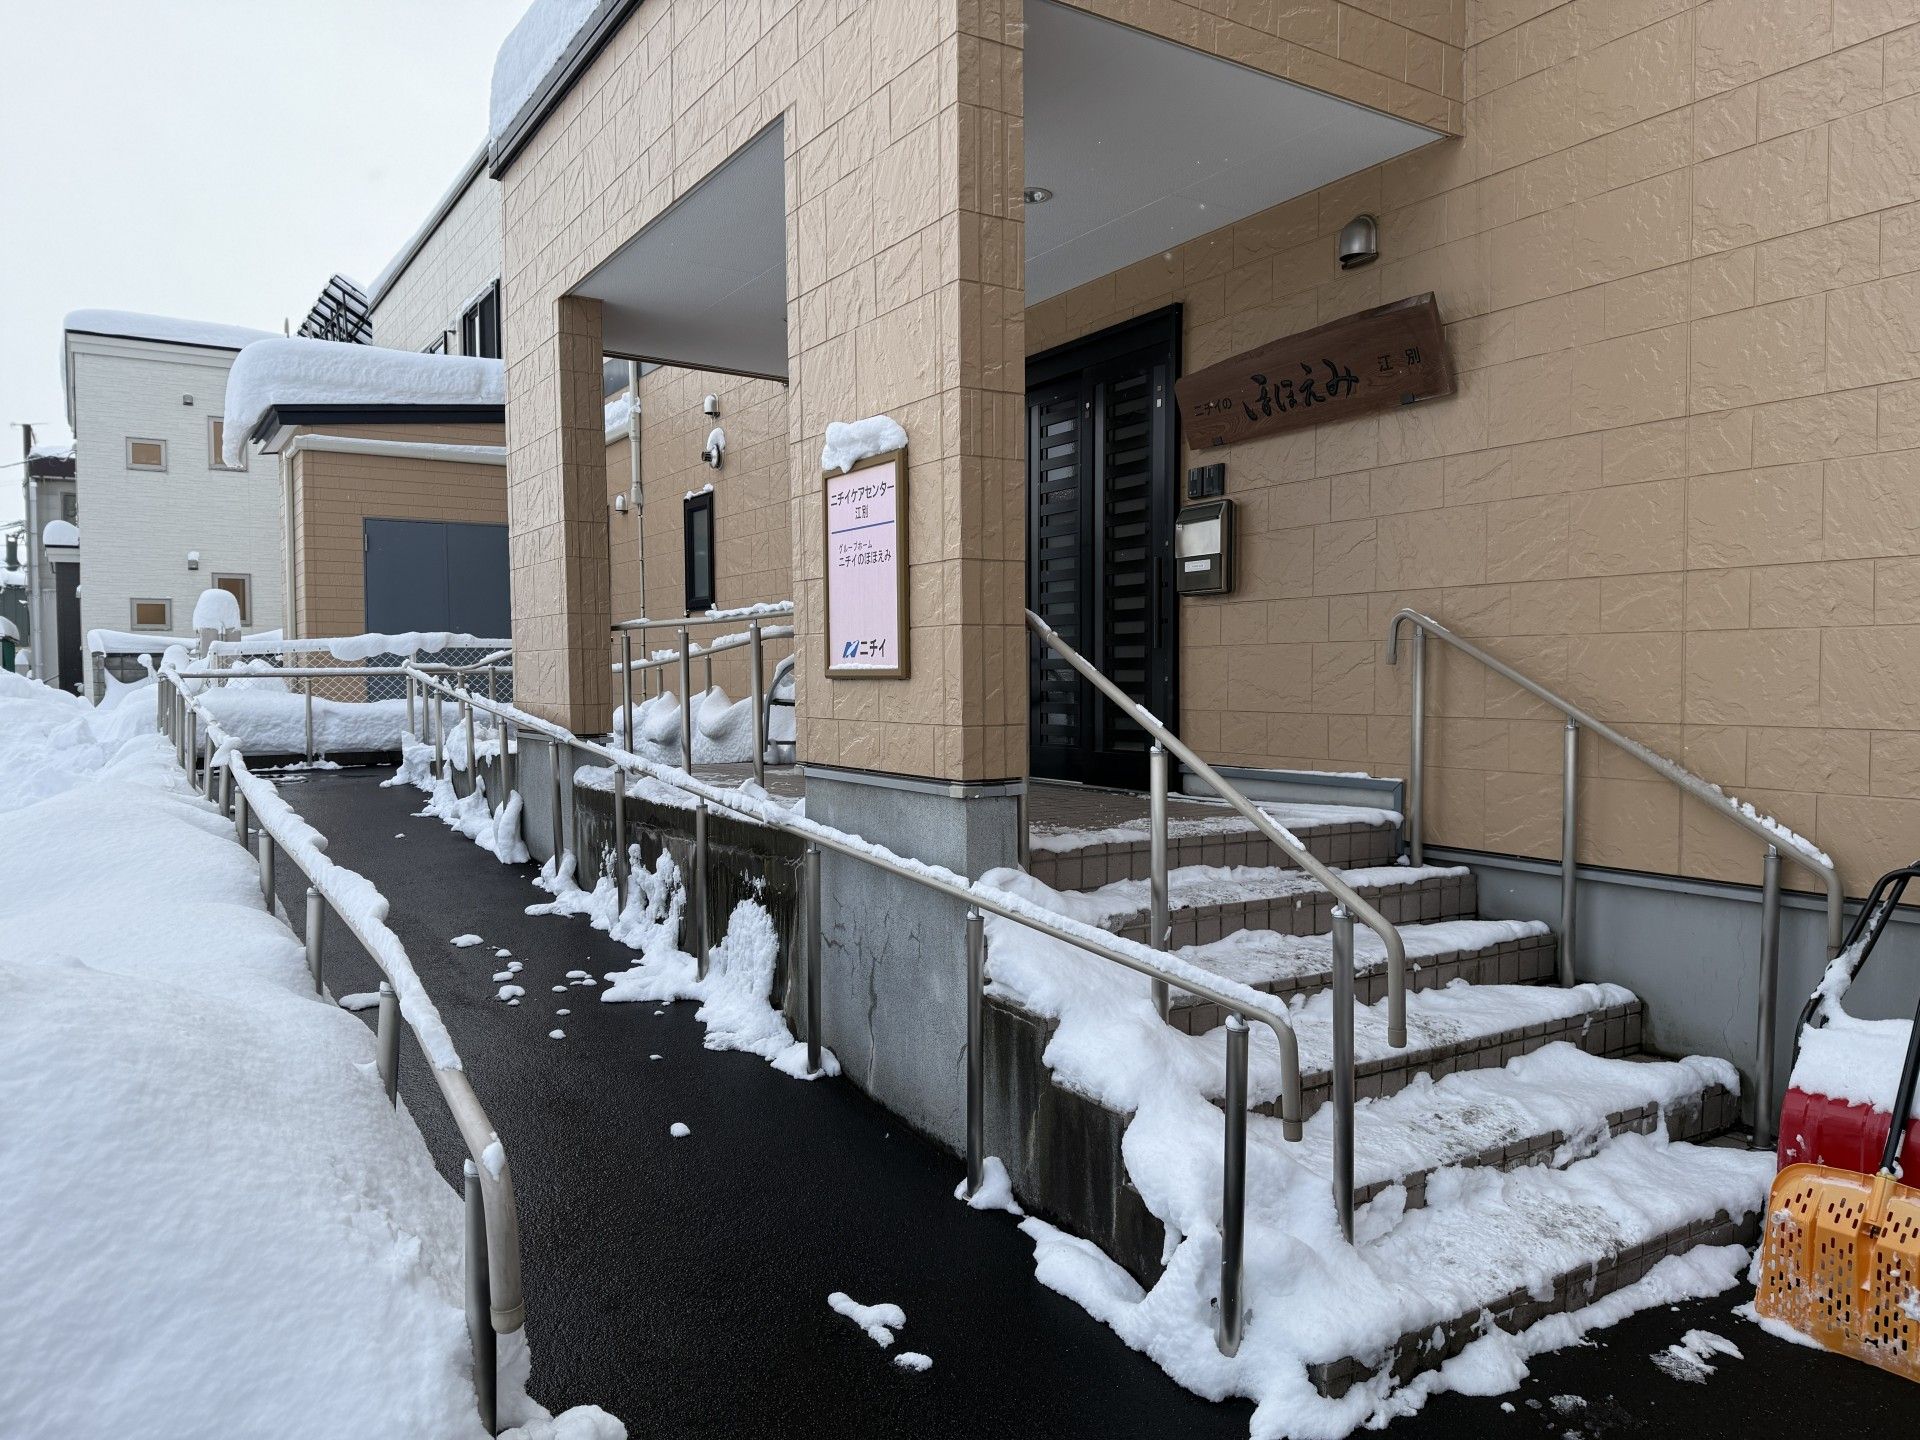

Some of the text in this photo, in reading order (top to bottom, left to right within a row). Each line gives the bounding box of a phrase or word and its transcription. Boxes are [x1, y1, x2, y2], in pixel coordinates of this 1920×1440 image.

[1194, 346, 1421, 420] ニチイの ほほえみ 江別
[831, 481, 894, 507] ニチイケアセンター
[855, 506, 869, 520] 江別
[839, 540, 873, 554] グループホーム
[838, 549, 892, 568] ニチイのほほえみ
[859, 638, 886, 658] ニチイ
